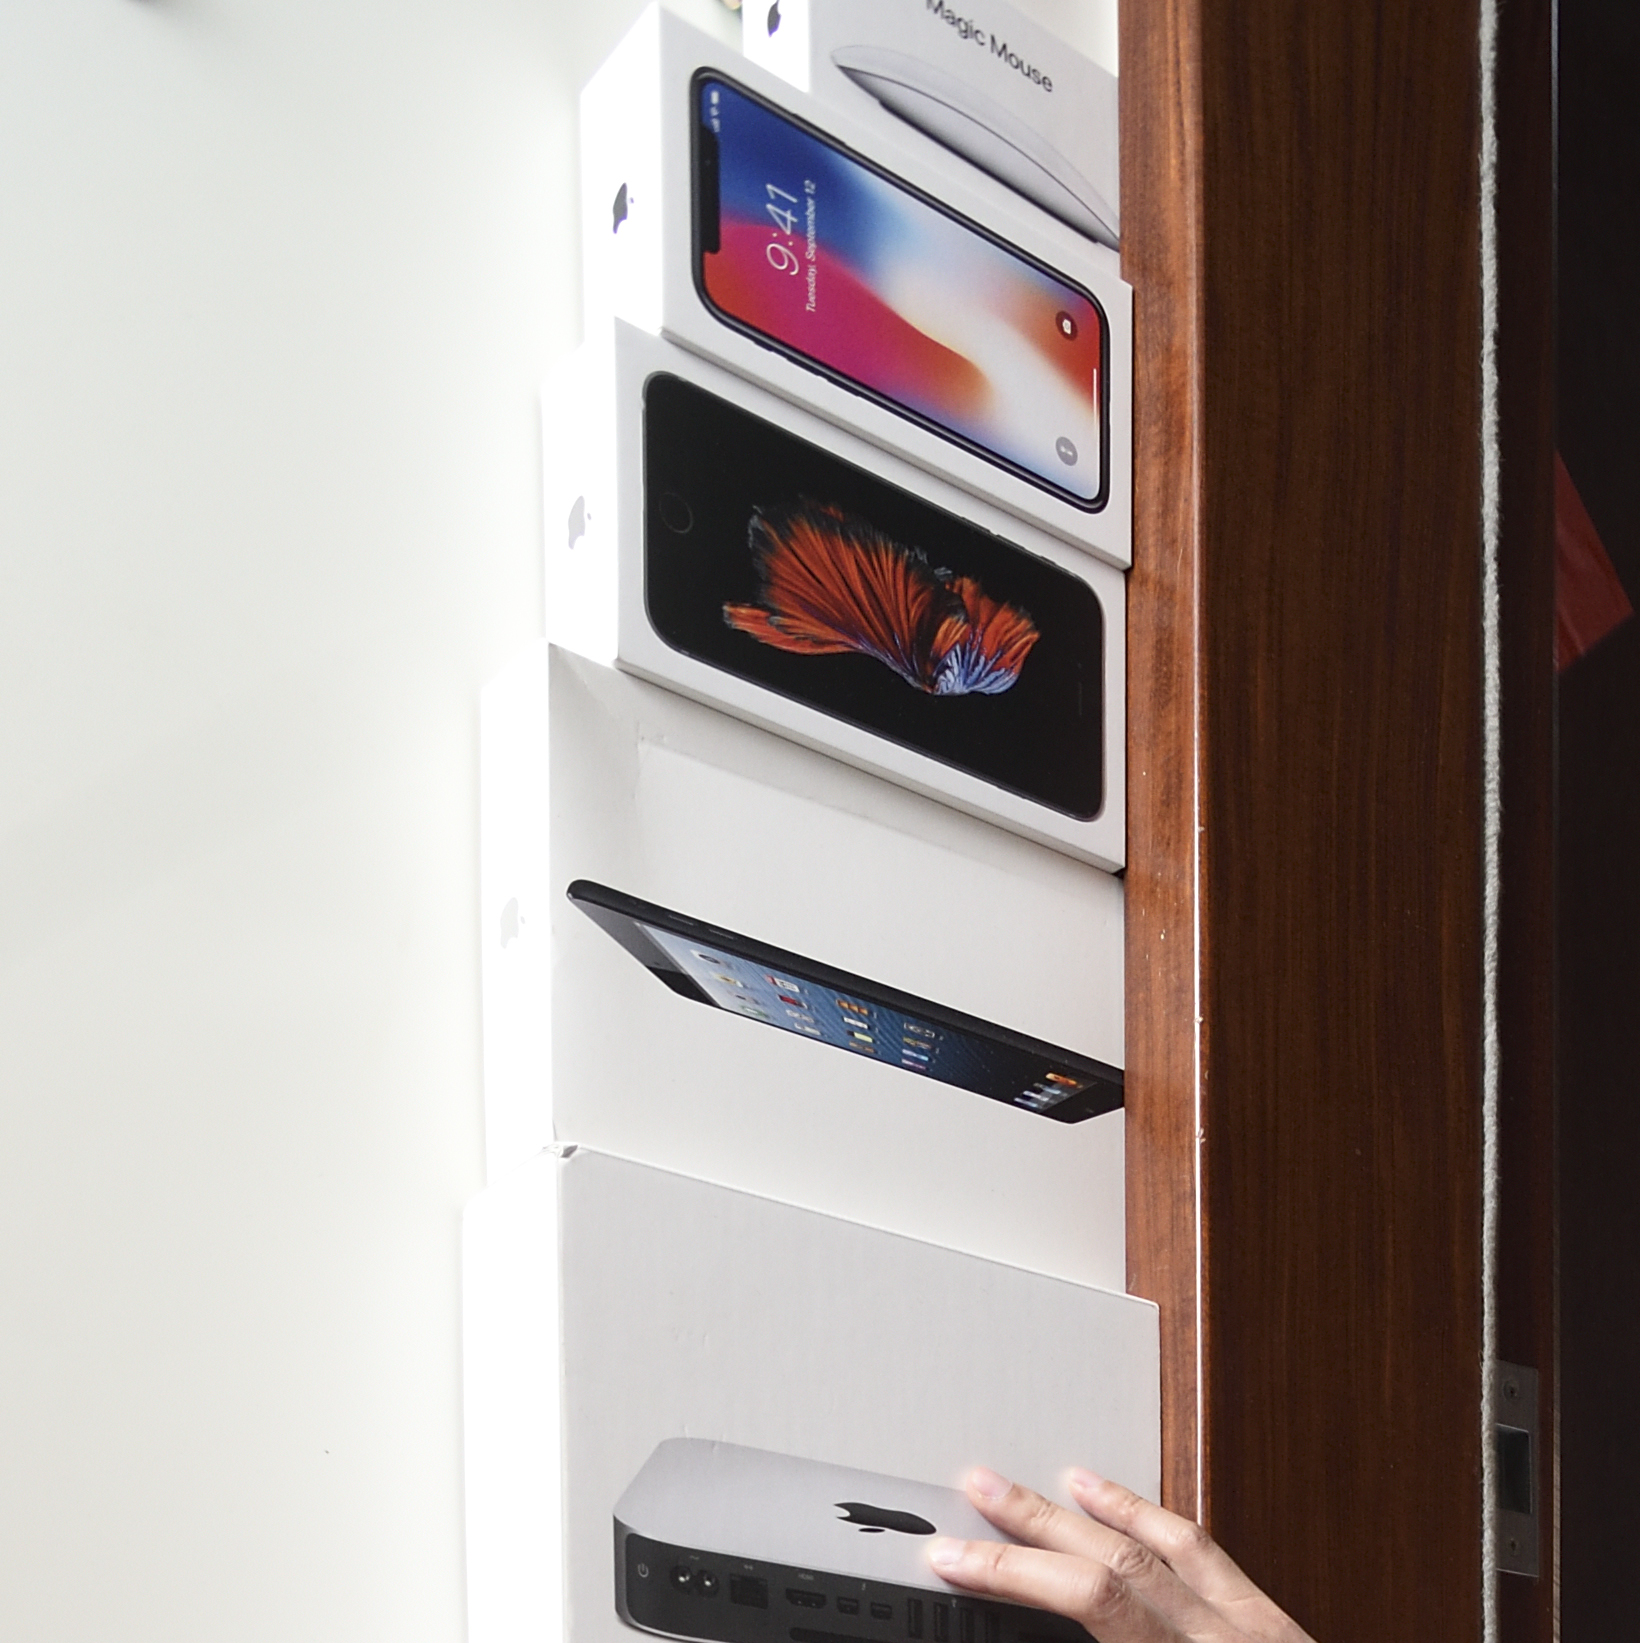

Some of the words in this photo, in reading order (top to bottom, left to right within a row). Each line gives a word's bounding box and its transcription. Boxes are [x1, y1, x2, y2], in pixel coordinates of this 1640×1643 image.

[926, 0, 986, 46] Magic
[990, 33, 1053, 93] Mouse
[804, 180, 816, 194] 12
[766, 184, 799, 276] 9:41
[805, 197, 817, 261] September
